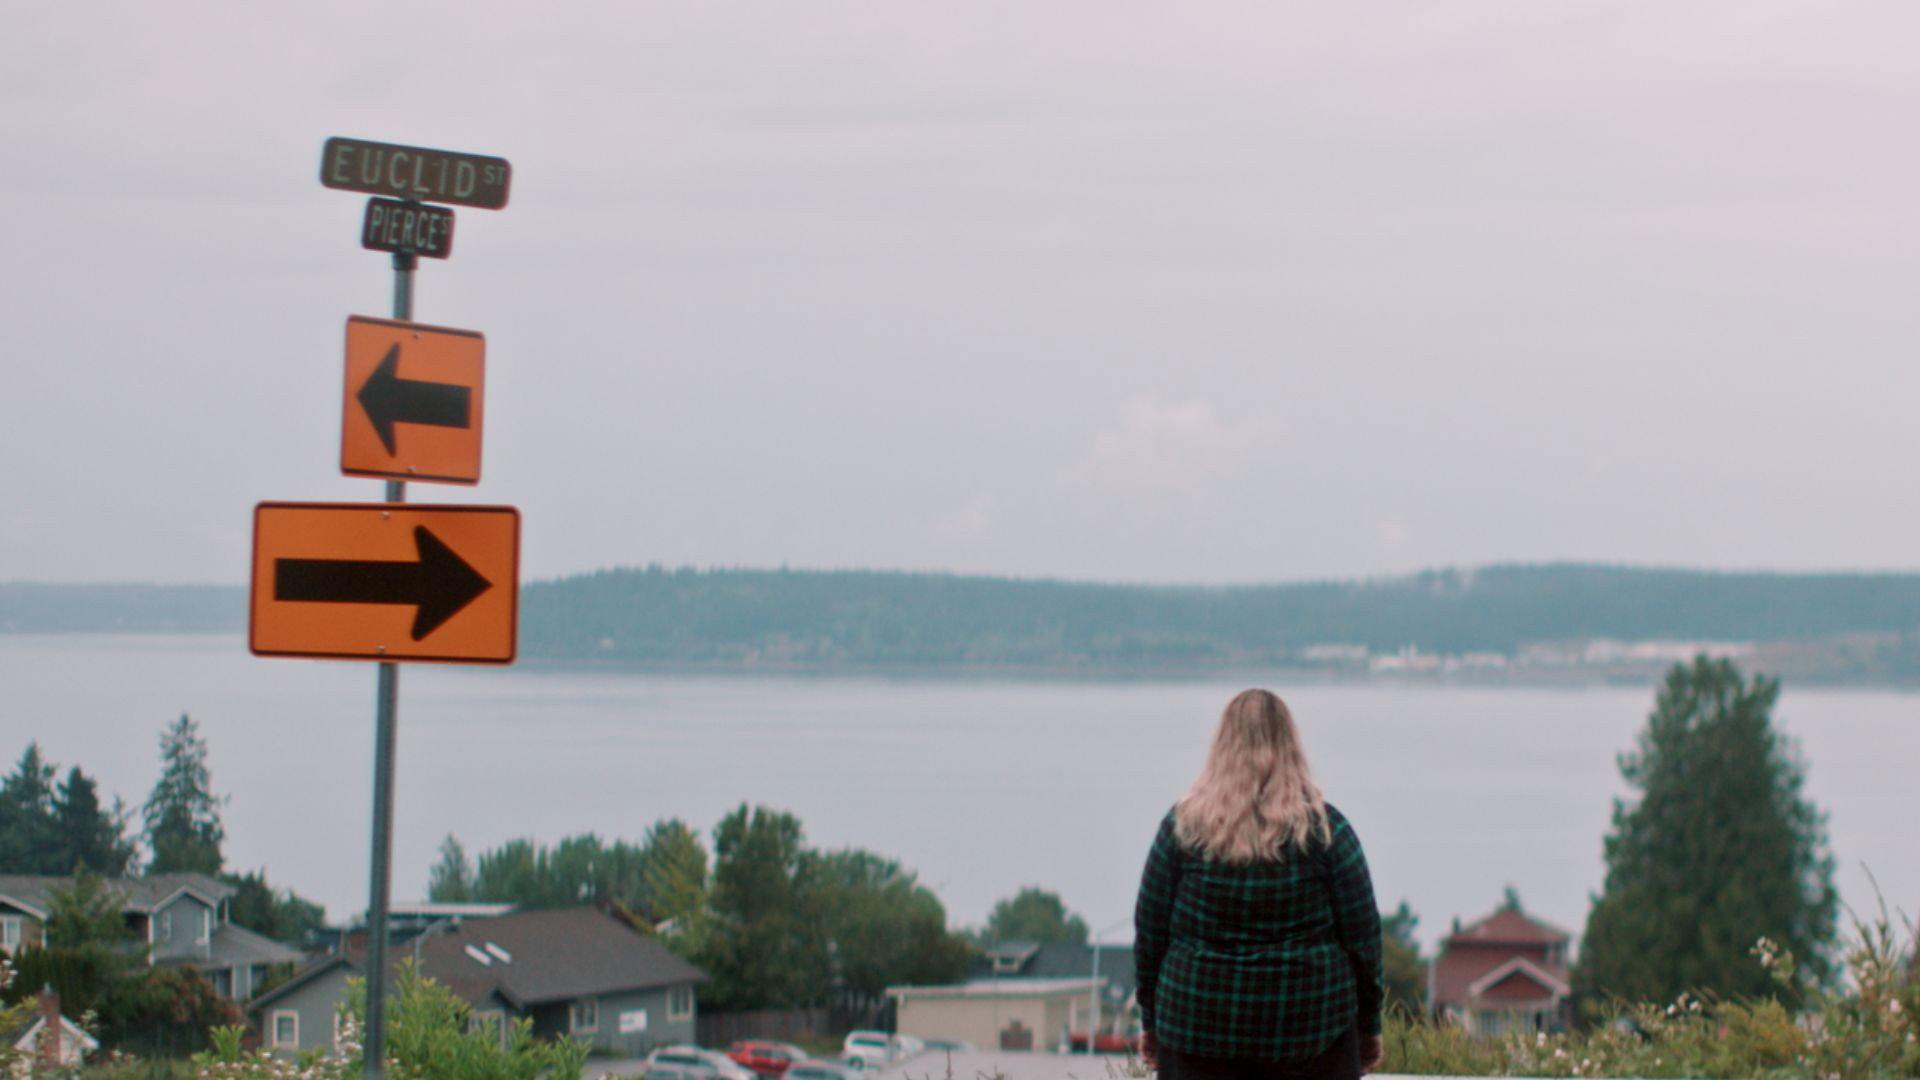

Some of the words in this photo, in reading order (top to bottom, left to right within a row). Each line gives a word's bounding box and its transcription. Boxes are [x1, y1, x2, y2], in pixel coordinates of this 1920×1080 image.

[332, 145, 477, 198] EUCLID
[483, 165, 505, 187] ST
[368, 205, 440, 250] PIERCE
